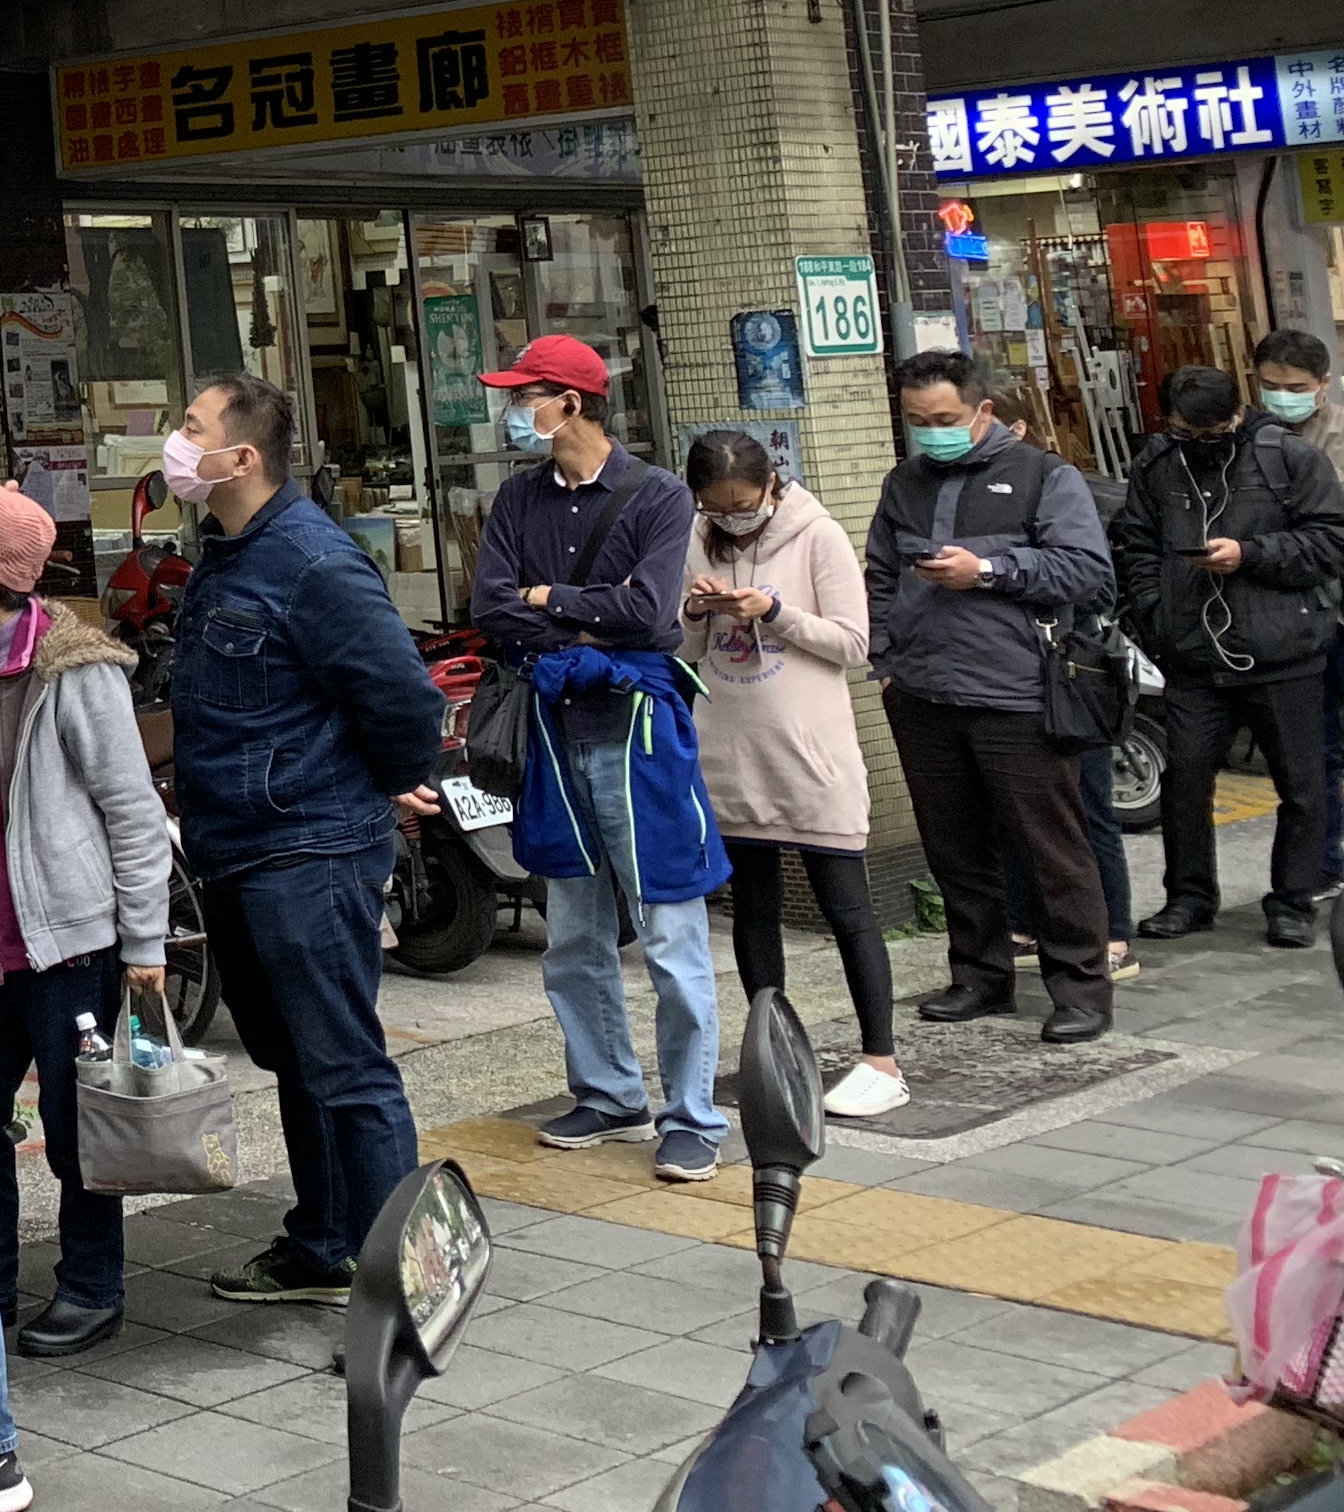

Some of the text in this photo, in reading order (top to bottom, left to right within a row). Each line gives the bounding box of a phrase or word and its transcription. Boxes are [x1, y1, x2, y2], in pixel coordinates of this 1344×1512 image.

[168, 29, 489, 142] 名冠畫廊
[927, 64, 1274, 173] 國泰美術社
[815, 295, 870, 341] 186
